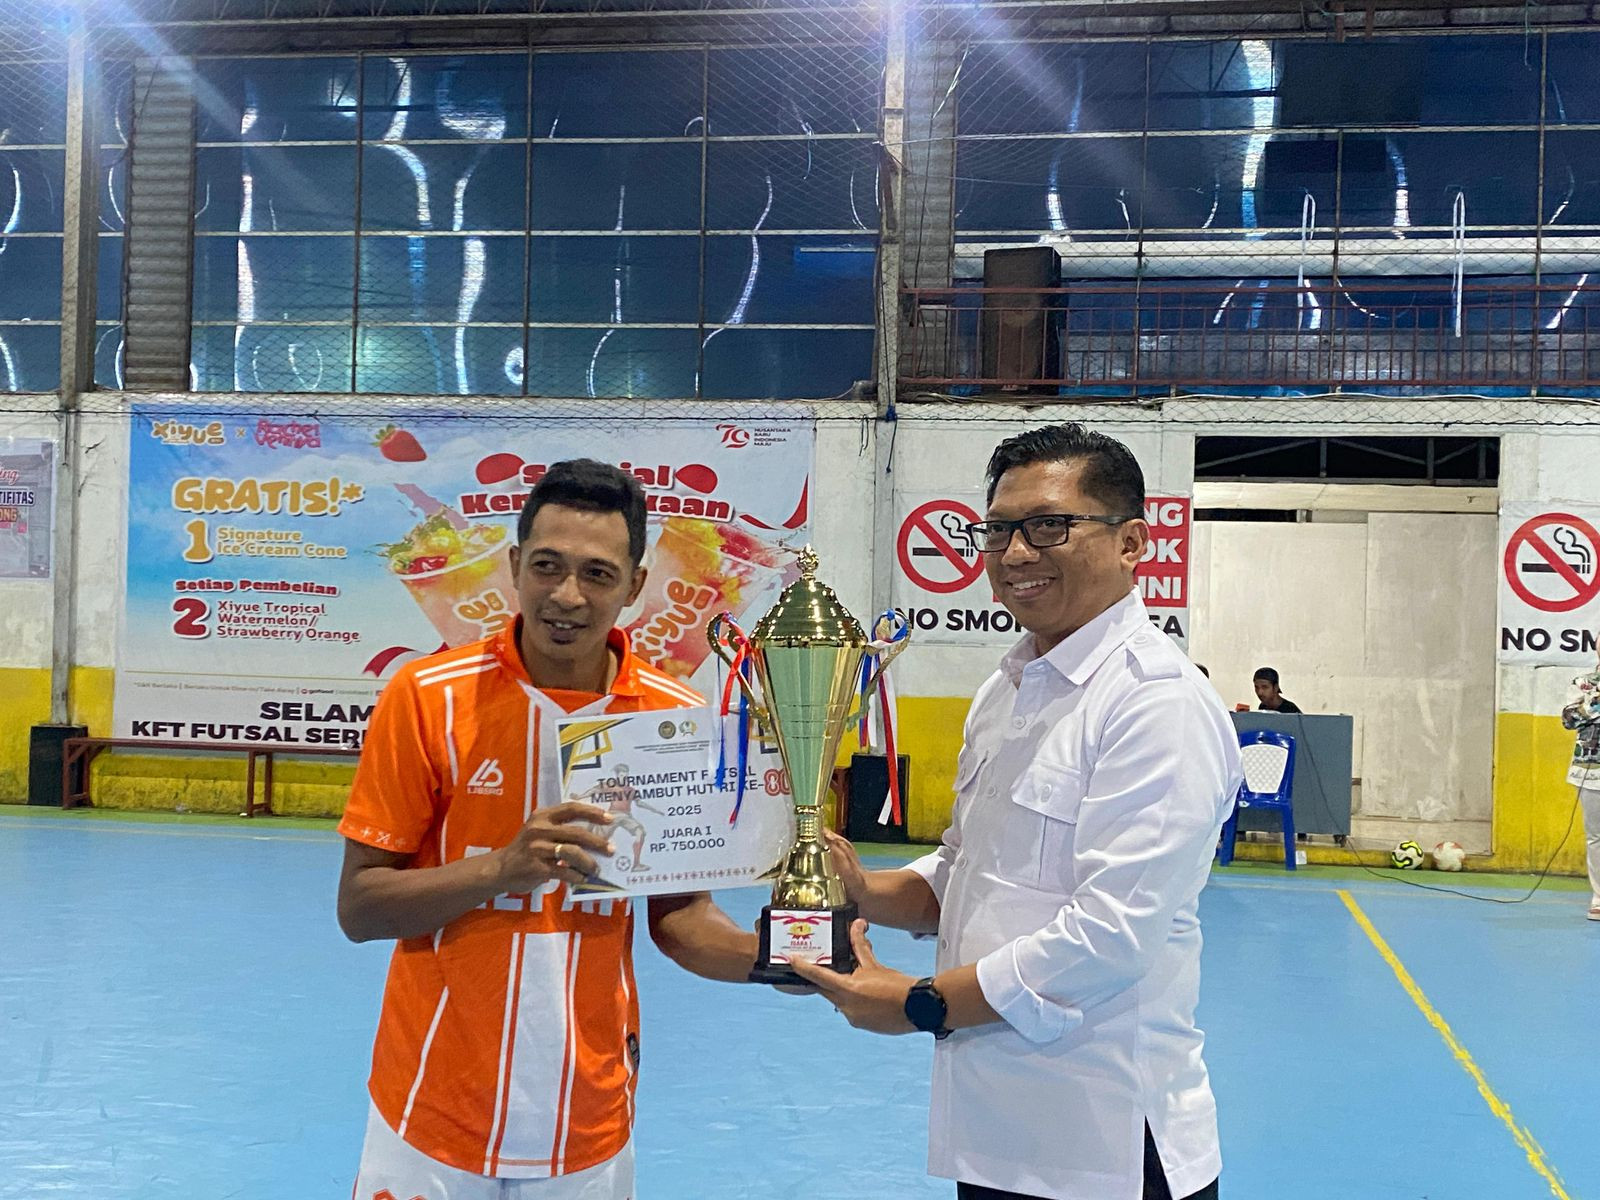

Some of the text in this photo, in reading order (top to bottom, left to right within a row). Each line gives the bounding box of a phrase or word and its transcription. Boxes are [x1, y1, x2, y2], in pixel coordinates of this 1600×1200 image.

[715, 423, 751, 448] 79
[1144, 502, 1184, 527] NG
[183, 519, 213, 562] 1
[218, 527, 302, 544] Signature
[218, 542, 348, 558] Ice Cream Cone
[1140, 538, 1184, 563] OK
[175, 579, 338, 596] Setiap Pembelian
[1138, 576, 1182, 599] INI
[173, 597, 208, 637] 2
[218, 600, 326, 616] Xiyue Tropical
[895, 608, 939, 631] NO
[217, 625, 361, 643] Strawberry Orange
[1502, 628, 1597, 652] NO SM
[260, 702, 376, 722] SELAM
[132, 720, 185, 738] KFT
[191, 723, 299, 743] FUTSAL
[597, 770, 697, 789] TOURNAMENT
[591, 786, 685, 804] MENYAMBUT
[687, 783, 715, 796] HUT
[668, 805, 702, 817] 2025
[662, 827, 703, 840] JUARA
[650, 838, 725, 853] RP. 750.000
